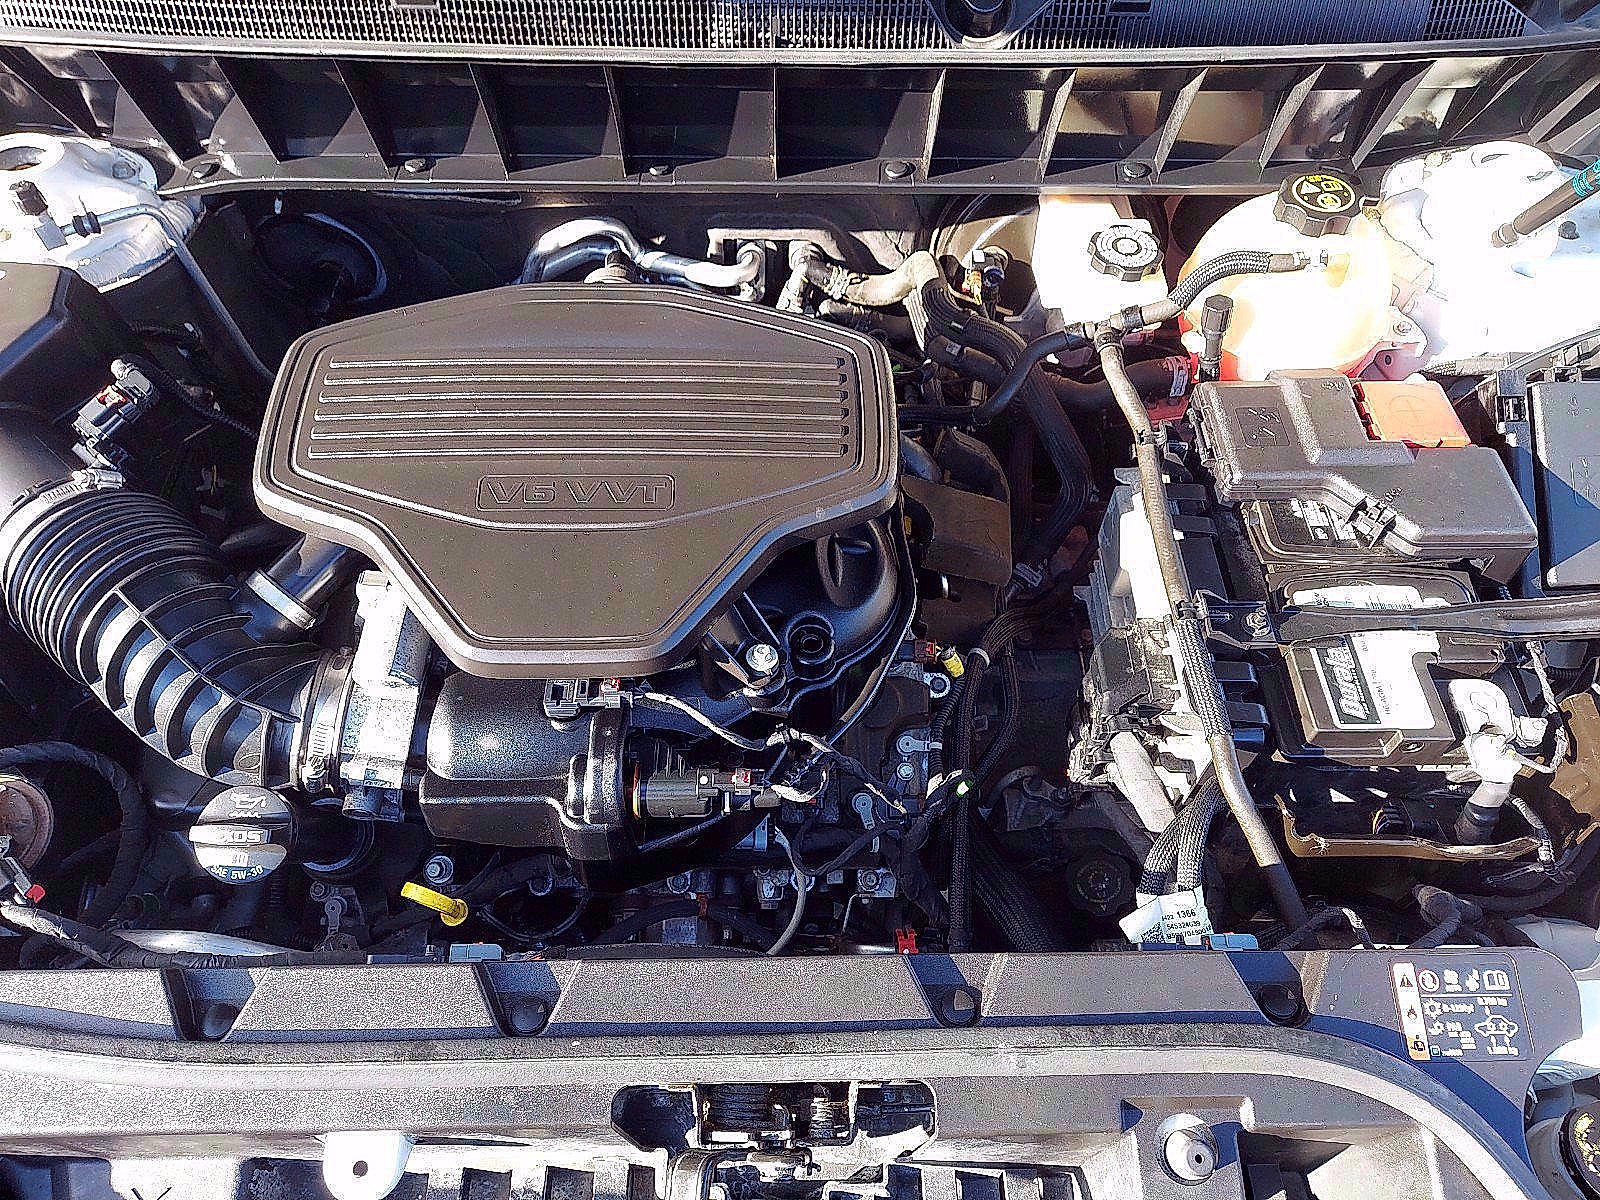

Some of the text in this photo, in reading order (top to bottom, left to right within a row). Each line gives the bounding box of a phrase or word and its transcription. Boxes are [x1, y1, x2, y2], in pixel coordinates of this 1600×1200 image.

[487, 481, 667, 503] V6 VVT
[211, 864, 264, 880] SAE 5W-30
